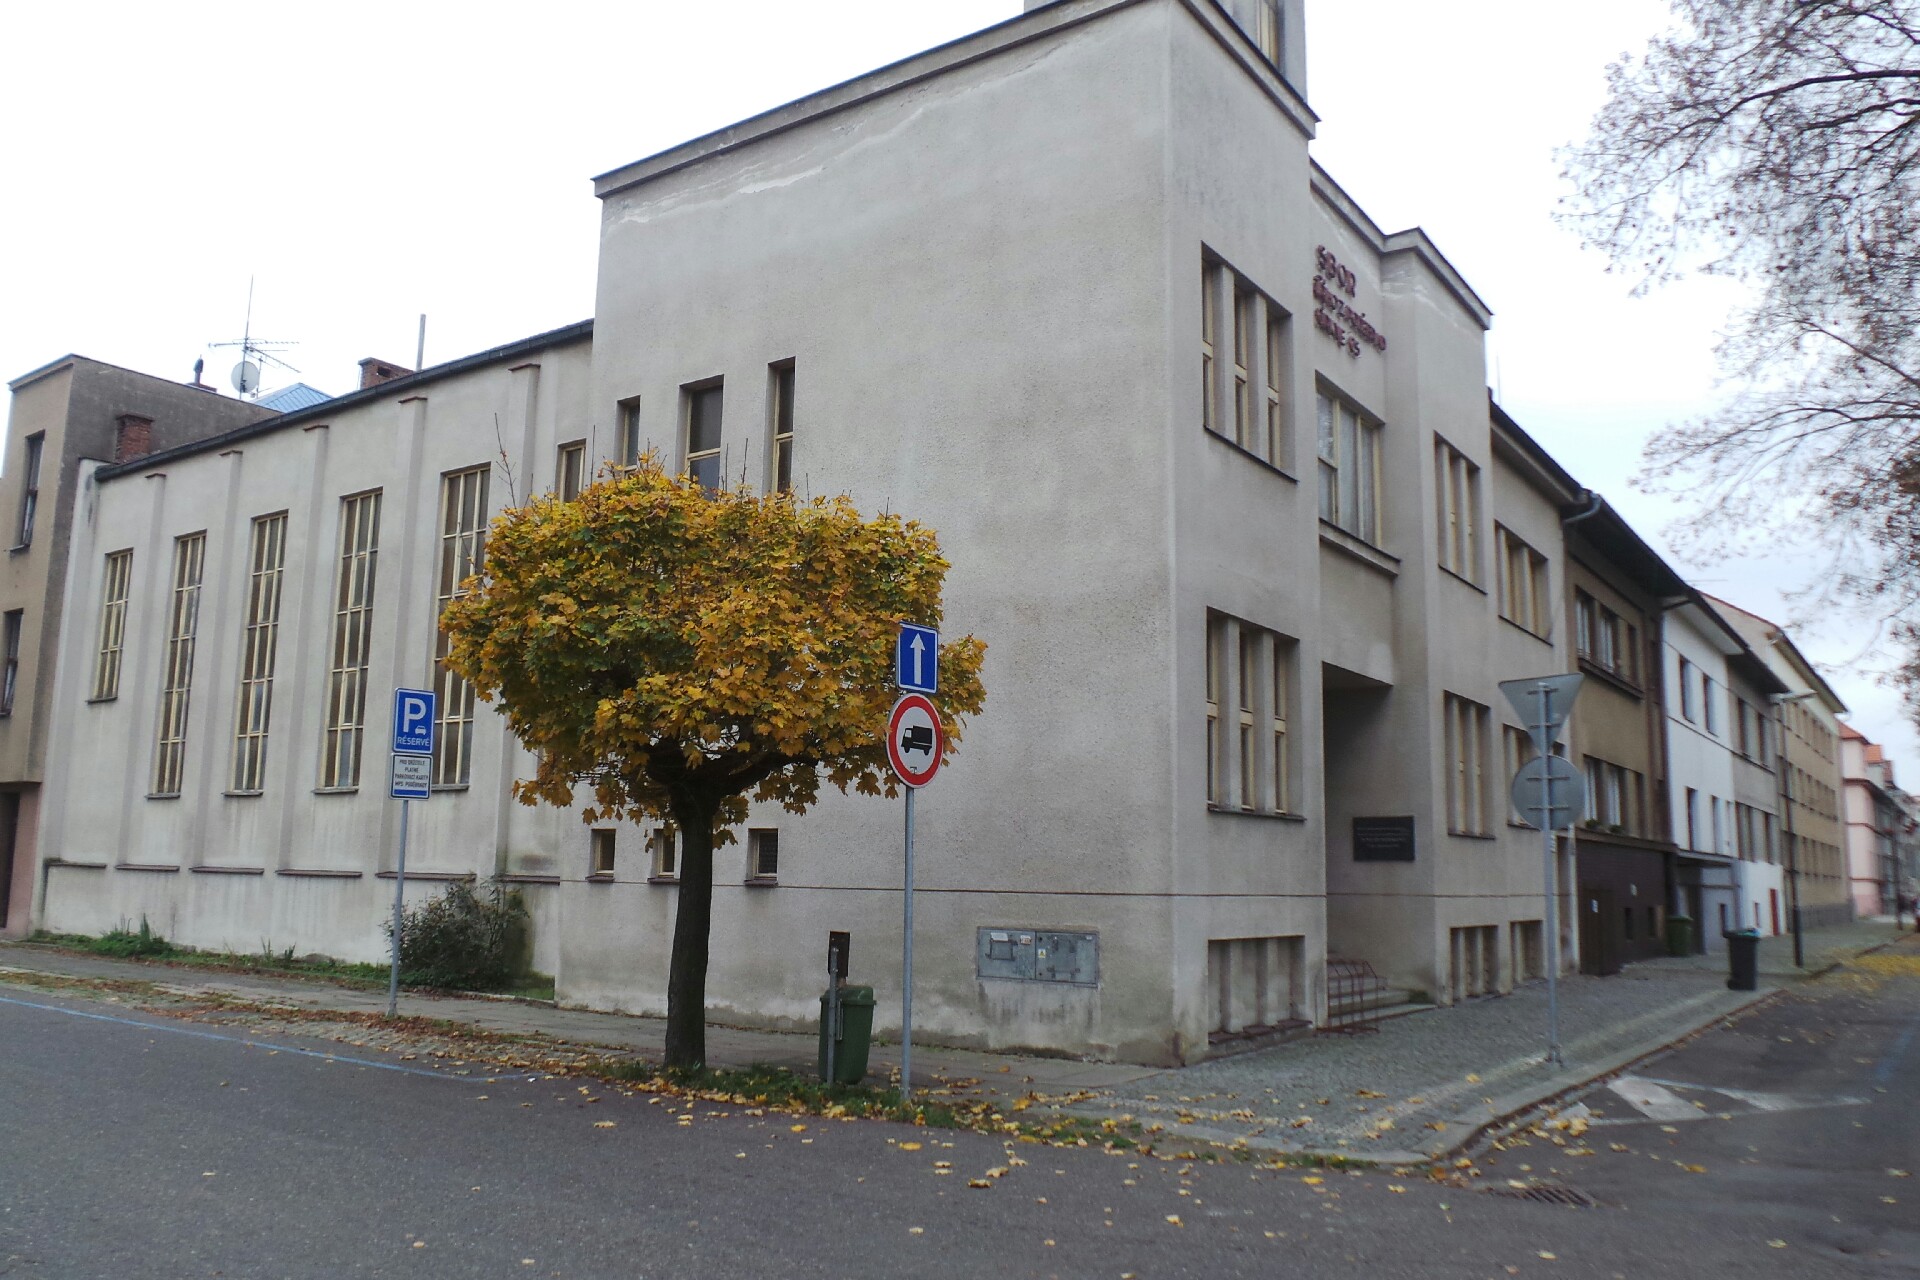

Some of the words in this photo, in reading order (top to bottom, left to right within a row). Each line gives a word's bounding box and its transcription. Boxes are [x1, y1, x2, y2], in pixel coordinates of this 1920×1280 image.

[1317, 244, 1356, 298] SBOR
[403, 697, 426, 733] P
[397, 735, 430, 747] RÉSERVÉ
